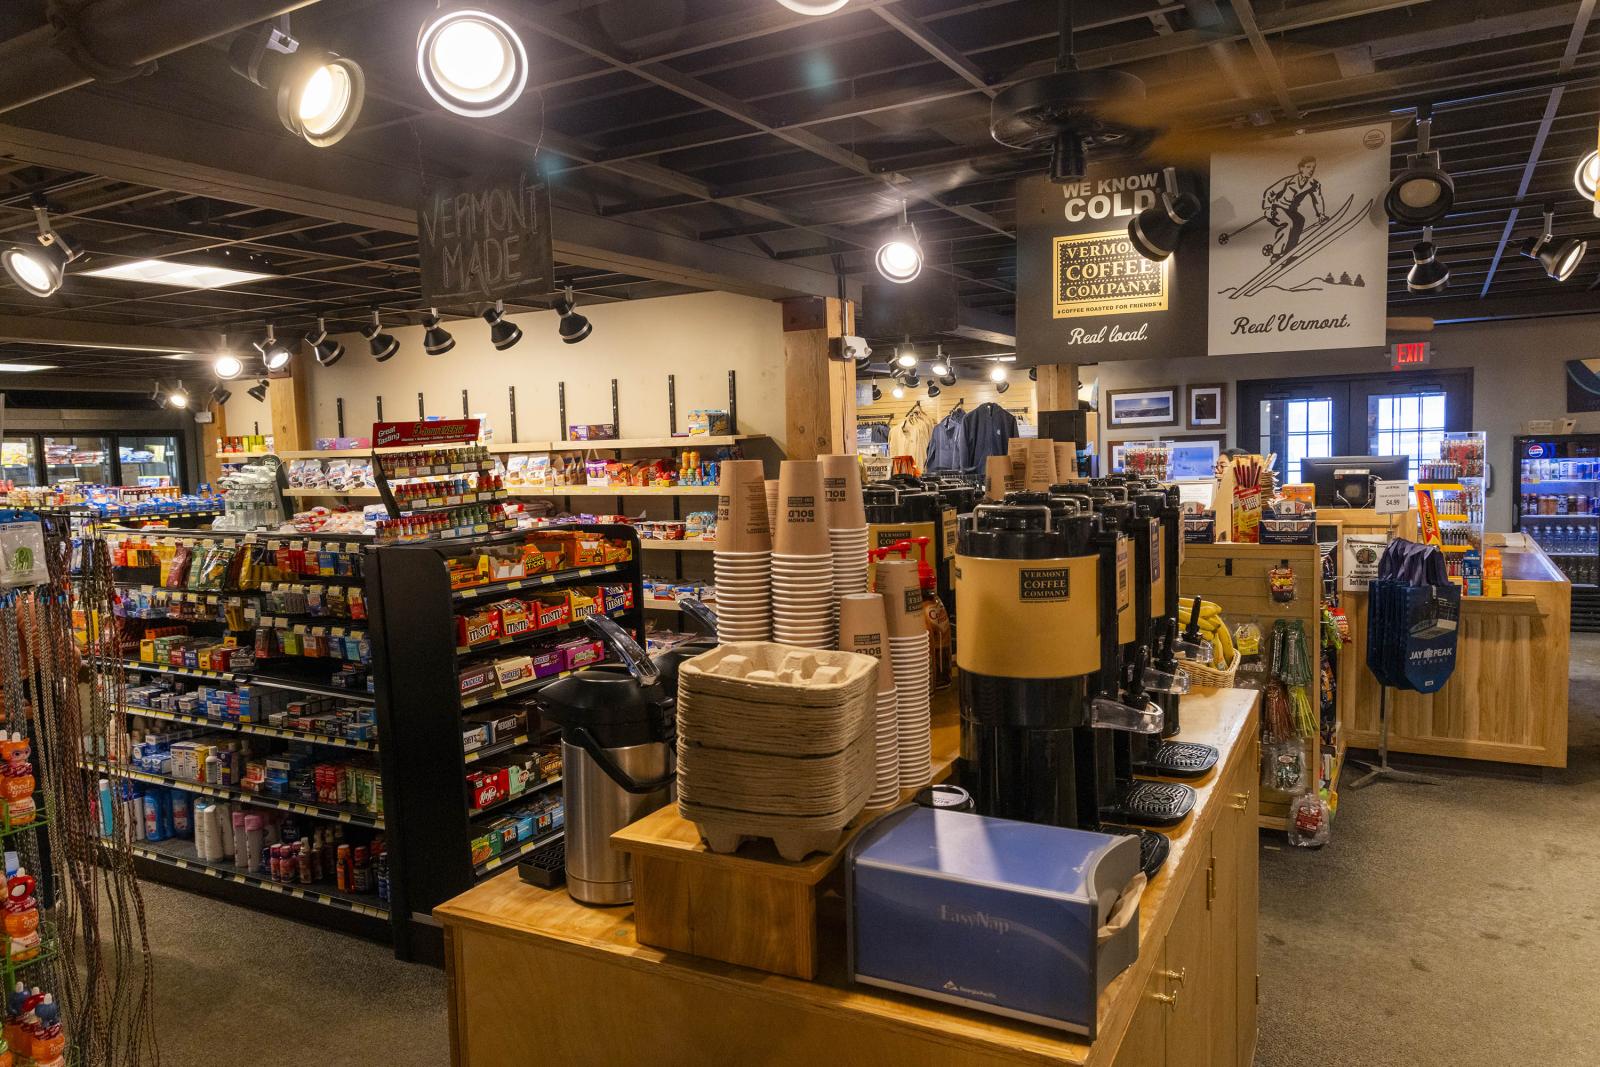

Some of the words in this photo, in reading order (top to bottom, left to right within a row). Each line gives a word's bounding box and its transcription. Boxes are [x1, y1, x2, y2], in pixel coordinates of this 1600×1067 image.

[1062, 182, 1092, 199] WE
[1097, 172, 1159, 194] KNOW
[423, 173, 545, 247] VERMONT
[1064, 189, 1156, 222] COLD
[1067, 241, 1136, 259] VERMO
[442, 235, 522, 297] MADE
[1066, 259, 1154, 281] COFFEE
[1066, 279, 1154, 298] COMPANY
[1061, 307, 1085, 315] COFFEE
[1230, 313, 1276, 335] Real
[1277, 313, 1351, 332] Vermont.
[1067, 325, 1108, 346] Real
[1108, 322, 1149, 343] local.
[1397, 342, 1424, 363] EXIT
[377, 426, 397, 438] Great
[377, 432, 401, 446] Tasting
[788, 509, 814, 518] BOLD
[1024, 570, 1066, 578] VERMONT
[1023, 580, 1066, 589] COFFEE
[1024, 590, 1066, 598] COMPANY
[1409, 650, 1424, 660] JAY
[1433, 647, 1453, 657] PEAK
[462, 673, 485, 688] SNICKERS
